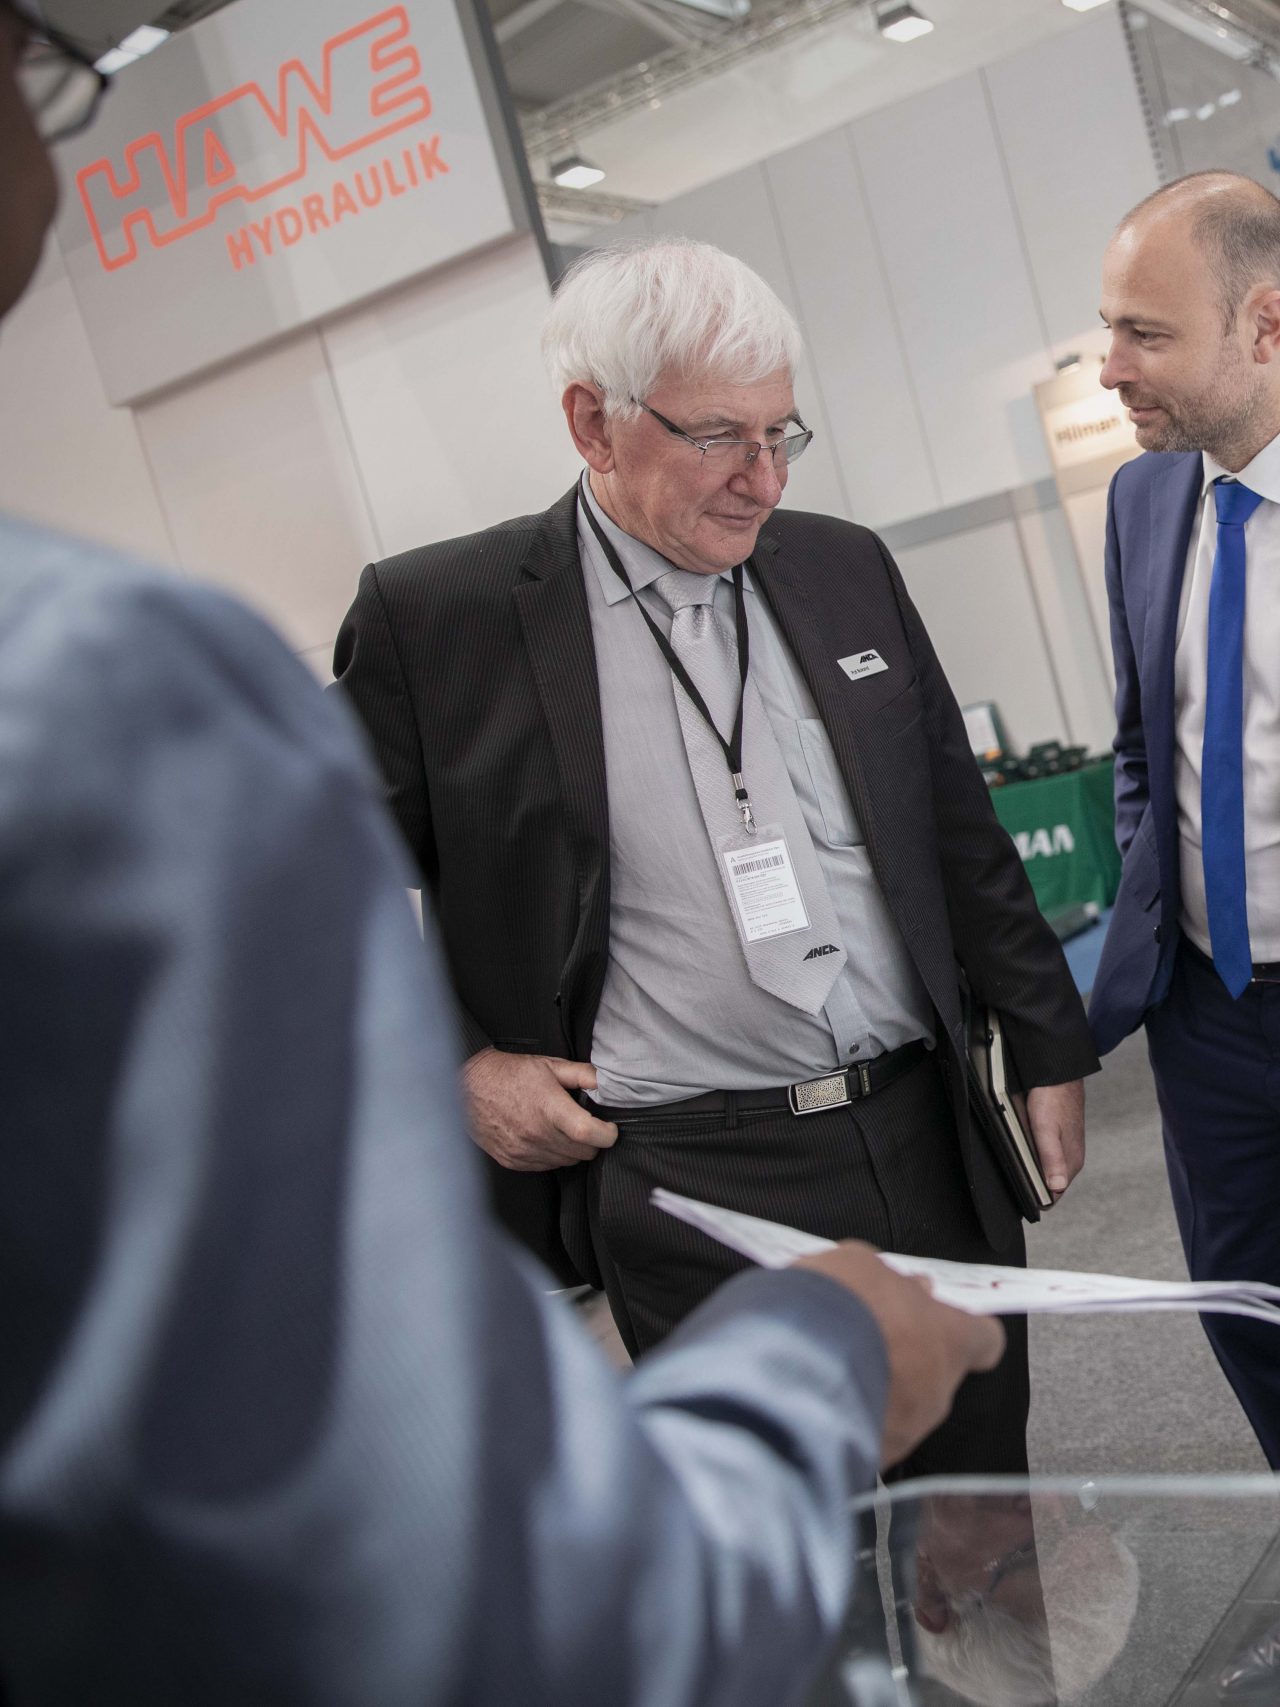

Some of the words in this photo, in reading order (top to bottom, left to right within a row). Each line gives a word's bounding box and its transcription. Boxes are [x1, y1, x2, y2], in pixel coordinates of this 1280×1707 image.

[76, 4, 433, 272] HAWE
[225, 135, 450, 271] HYDRAULIK
[802, 943, 841, 962] ANCA
